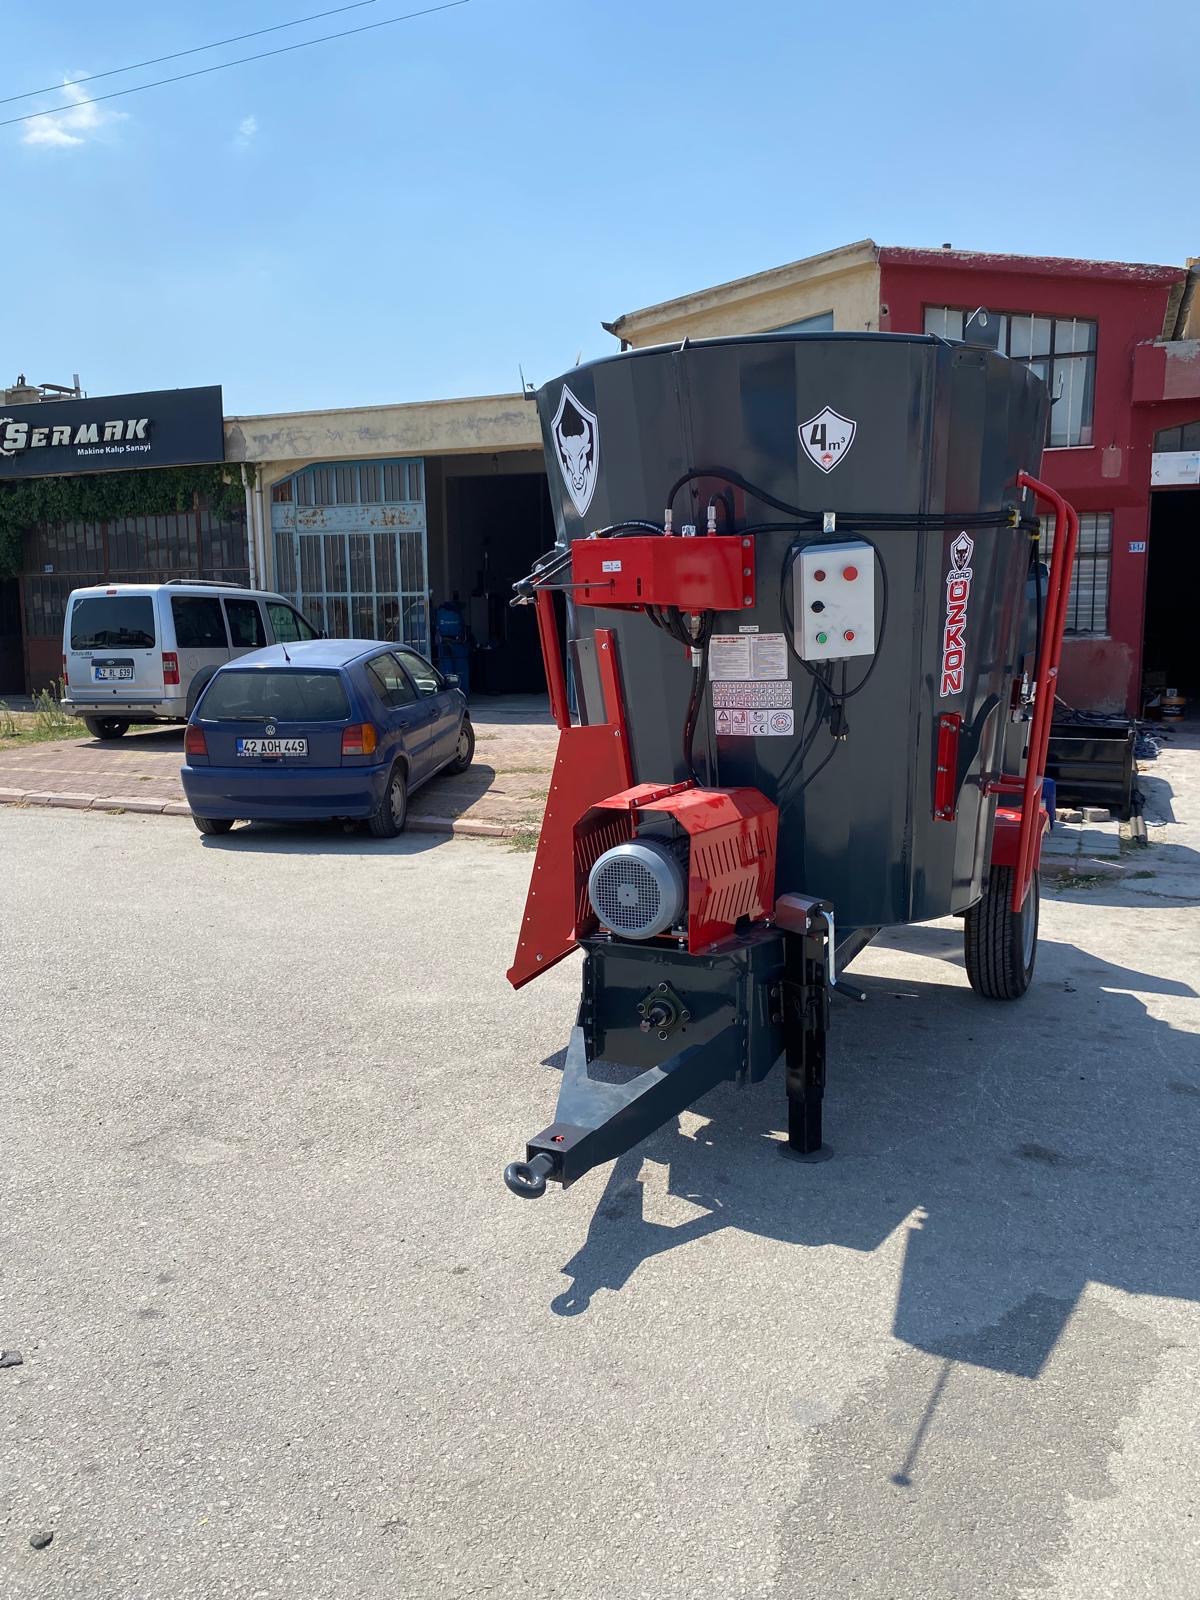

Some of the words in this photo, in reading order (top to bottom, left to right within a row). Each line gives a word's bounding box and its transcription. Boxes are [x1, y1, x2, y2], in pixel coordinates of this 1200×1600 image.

[3, 418, 149, 449] SERMAK
[77, 445, 104, 456] Makine
[125, 443, 151, 453] Sanayi
[949, 571, 970, 580] AGRO
[119, 668, 131, 677] 639
[244, 741, 257, 753] 42
[261, 741, 281, 753] AOH
[284, 741, 305, 753] 449
